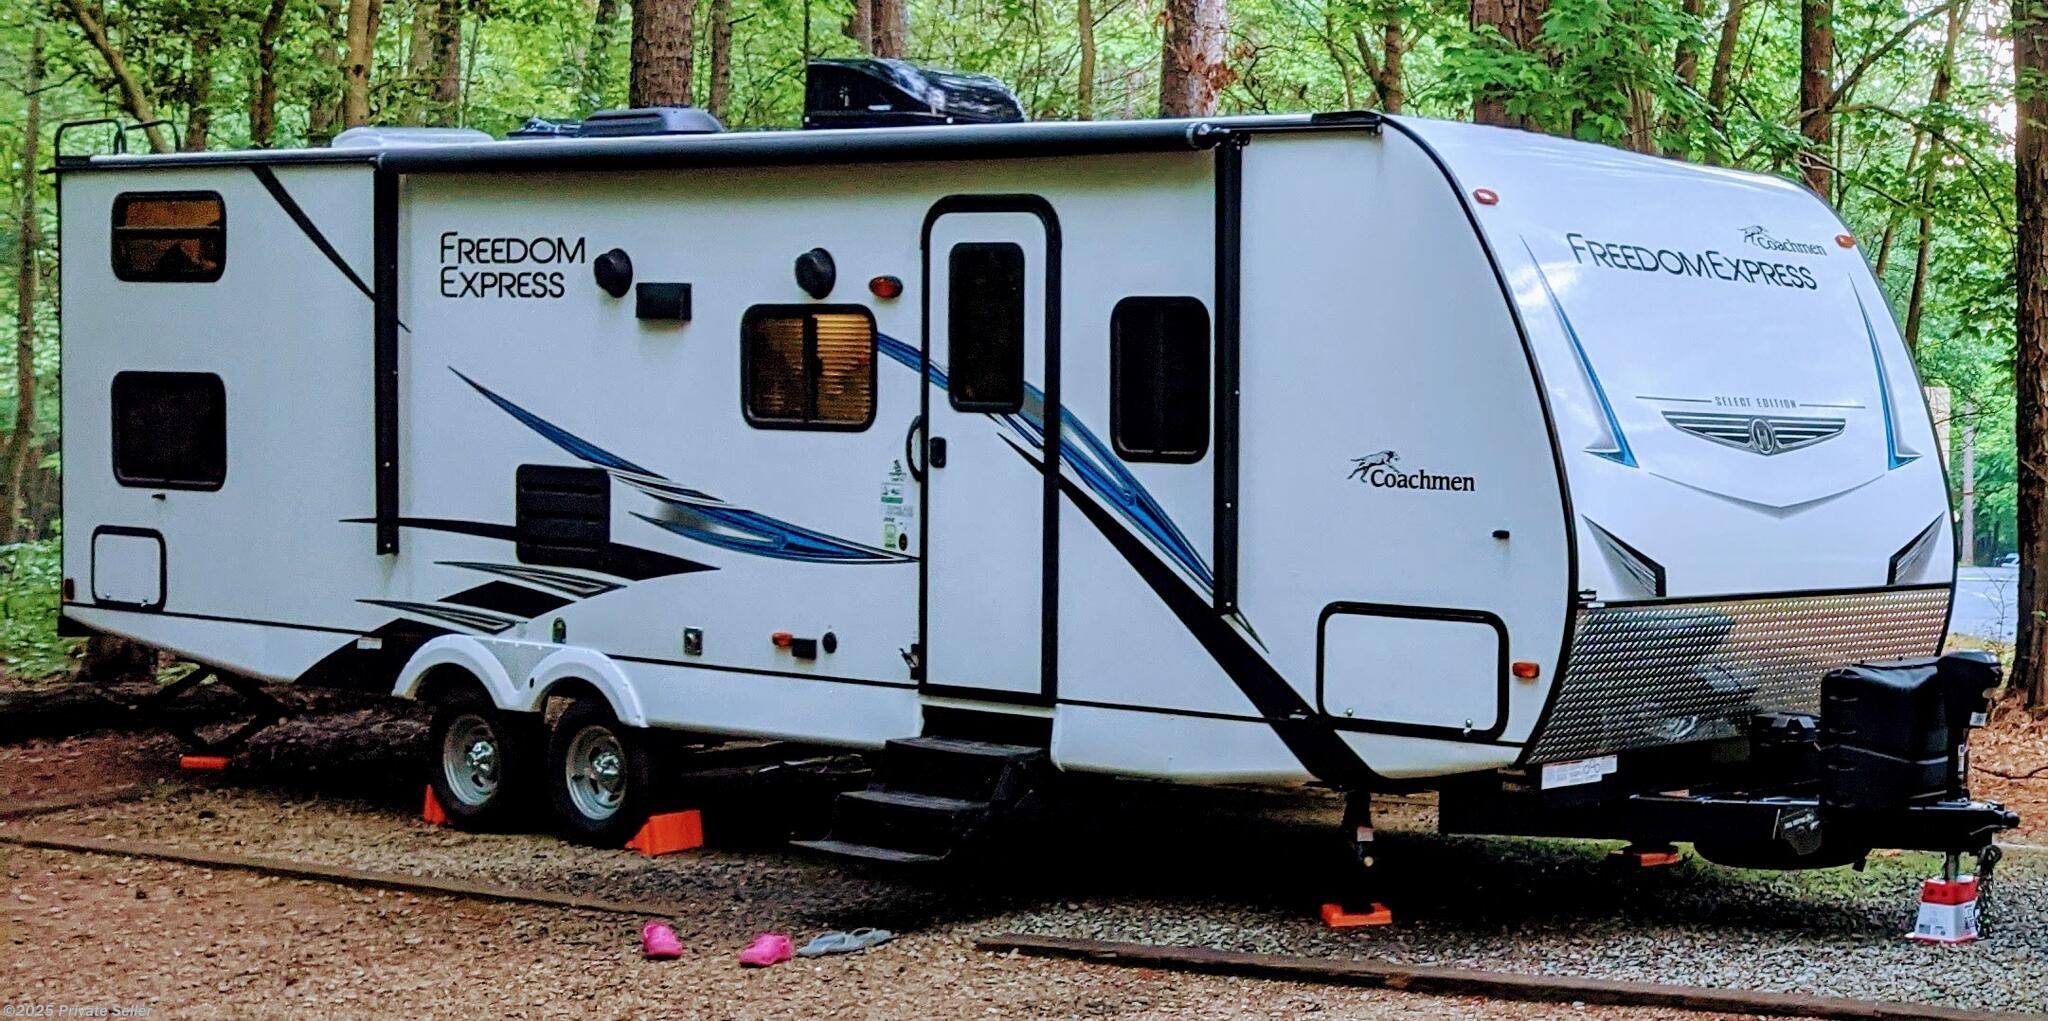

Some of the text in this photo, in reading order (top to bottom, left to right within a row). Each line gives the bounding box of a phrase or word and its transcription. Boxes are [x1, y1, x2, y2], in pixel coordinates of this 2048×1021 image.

[440, 231, 586, 264] FREEDOM
[1757, 237, 1828, 256] Coachmen
[440, 266, 565, 298] EXPRESS
[1714, 395, 1797, 409] SELECT EDITION
[1370, 469, 1476, 491] Coachmen
